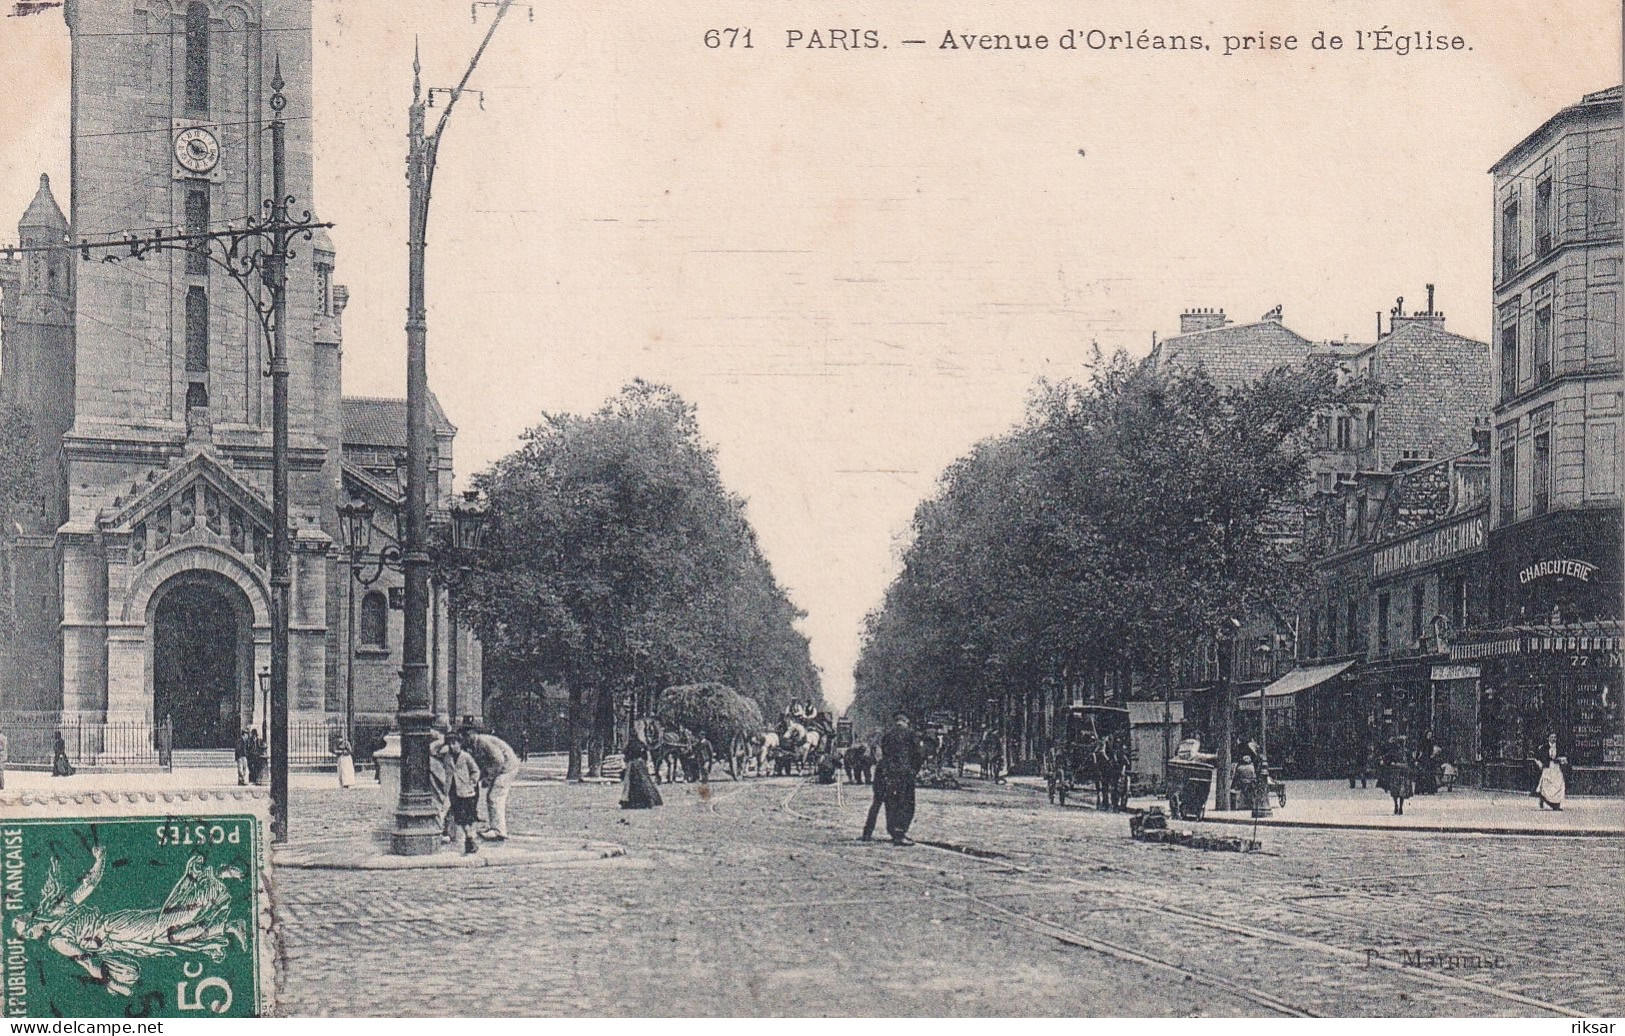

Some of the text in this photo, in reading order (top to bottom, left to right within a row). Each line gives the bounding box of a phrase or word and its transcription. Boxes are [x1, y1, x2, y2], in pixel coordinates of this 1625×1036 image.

[1373, 539, 1420, 577] PHARMACIE
[1440, 518, 1483, 556] CHEMINS
[1519, 560, 1592, 584] CHARCUTERIE
[1570, 655, 1588, 667] 77
[156, 825, 240, 846] POSTES
[6, 828, 25, 911] FRANÇAISE
